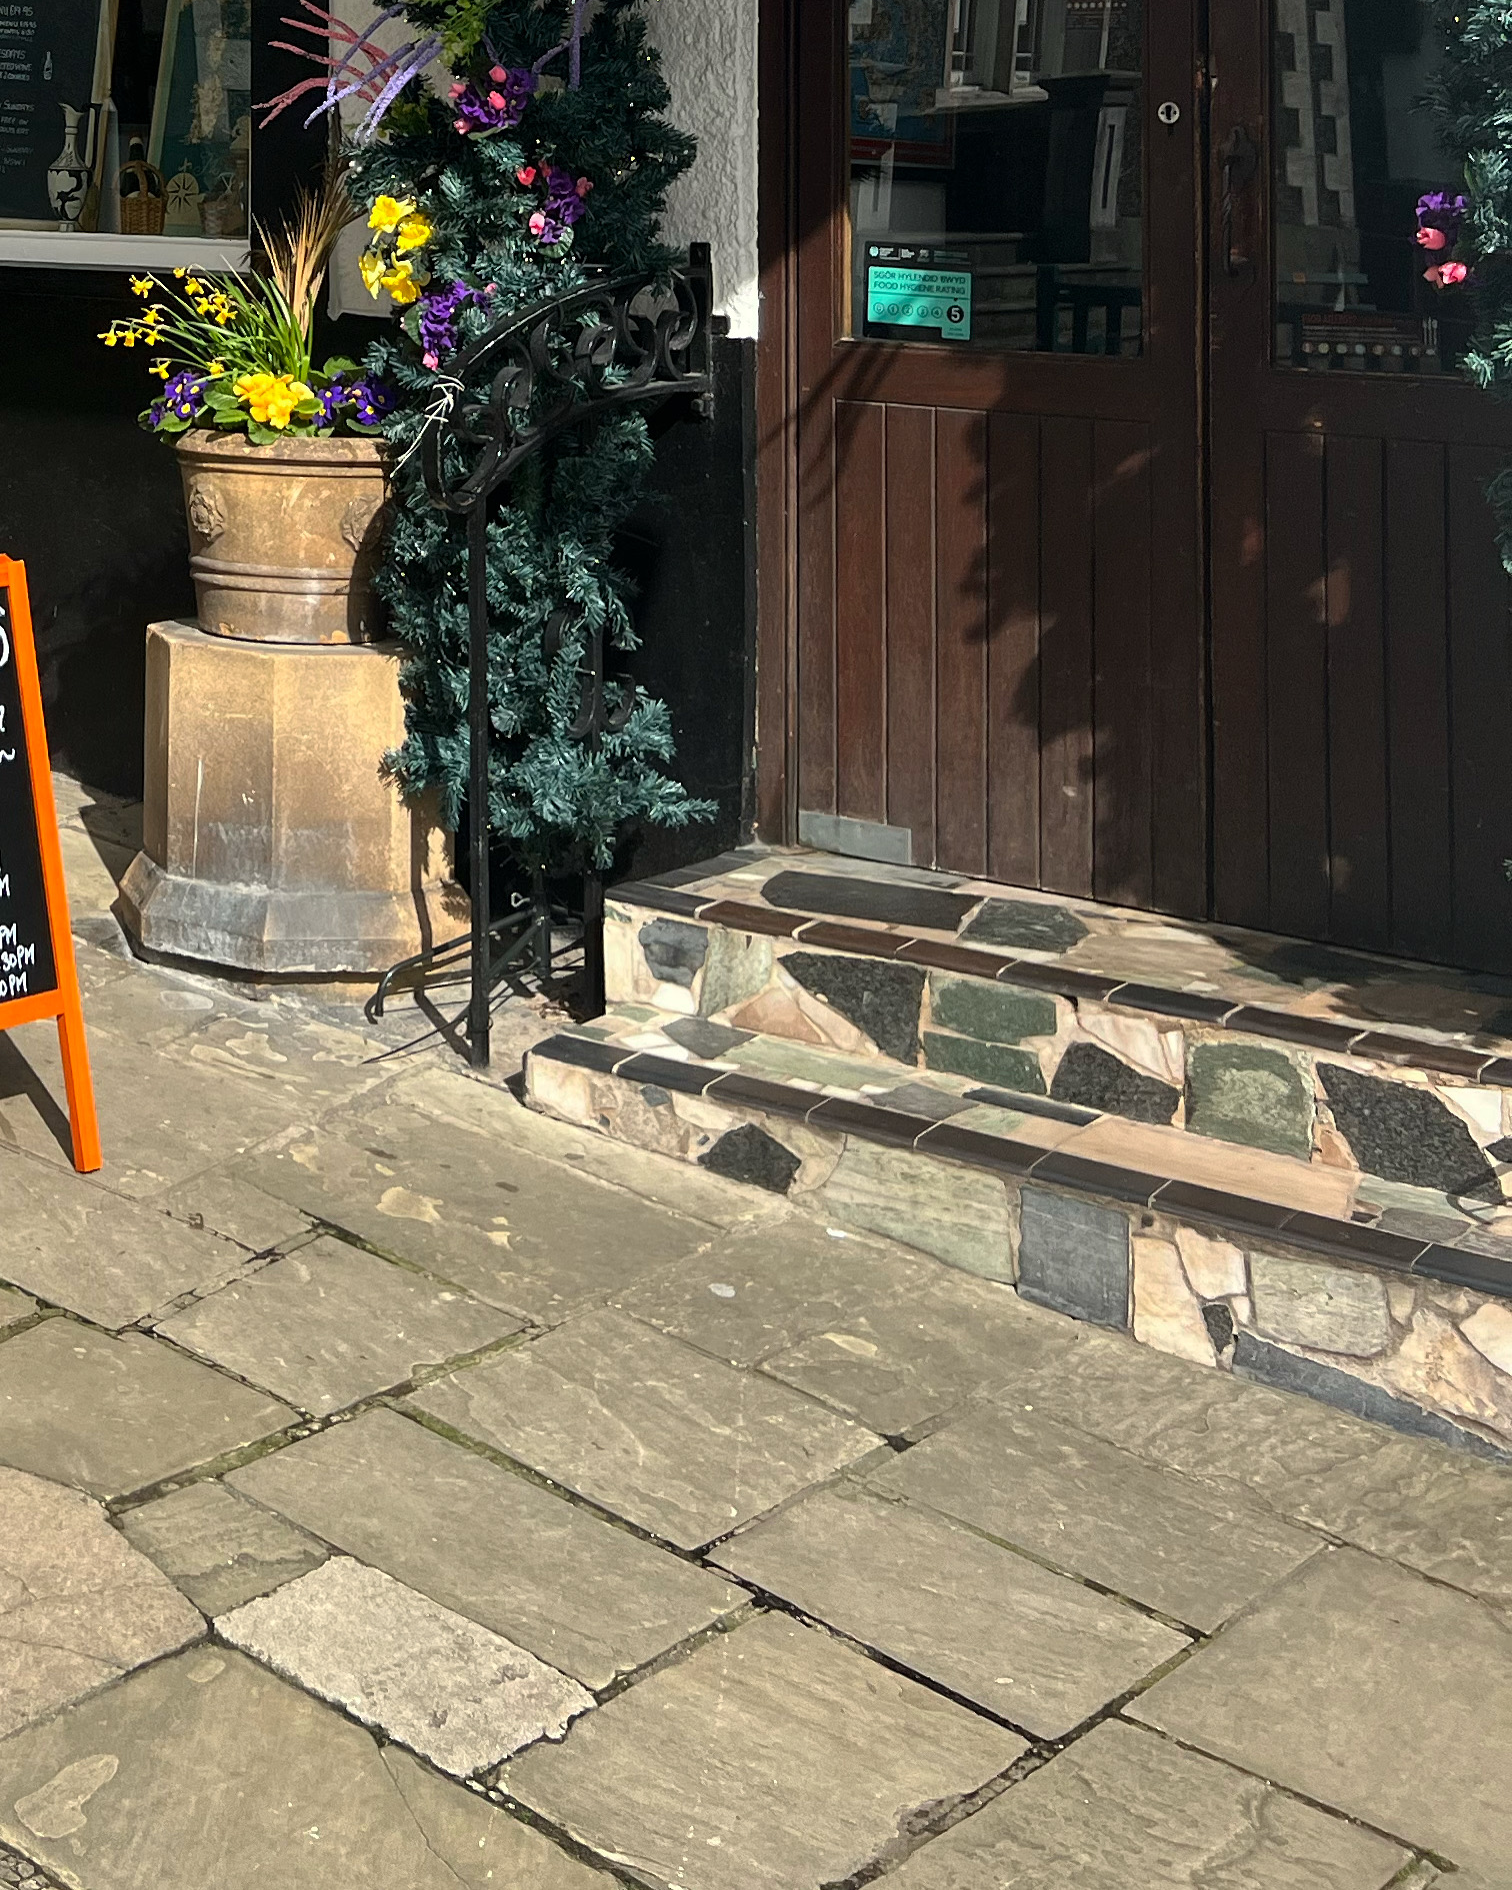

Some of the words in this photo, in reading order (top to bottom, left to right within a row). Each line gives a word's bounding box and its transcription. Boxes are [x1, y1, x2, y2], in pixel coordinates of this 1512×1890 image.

[874, 281, 898, 290] FOOD
[899, 282, 935, 293] HYGIENE
[935, 285, 966, 295] RATING
